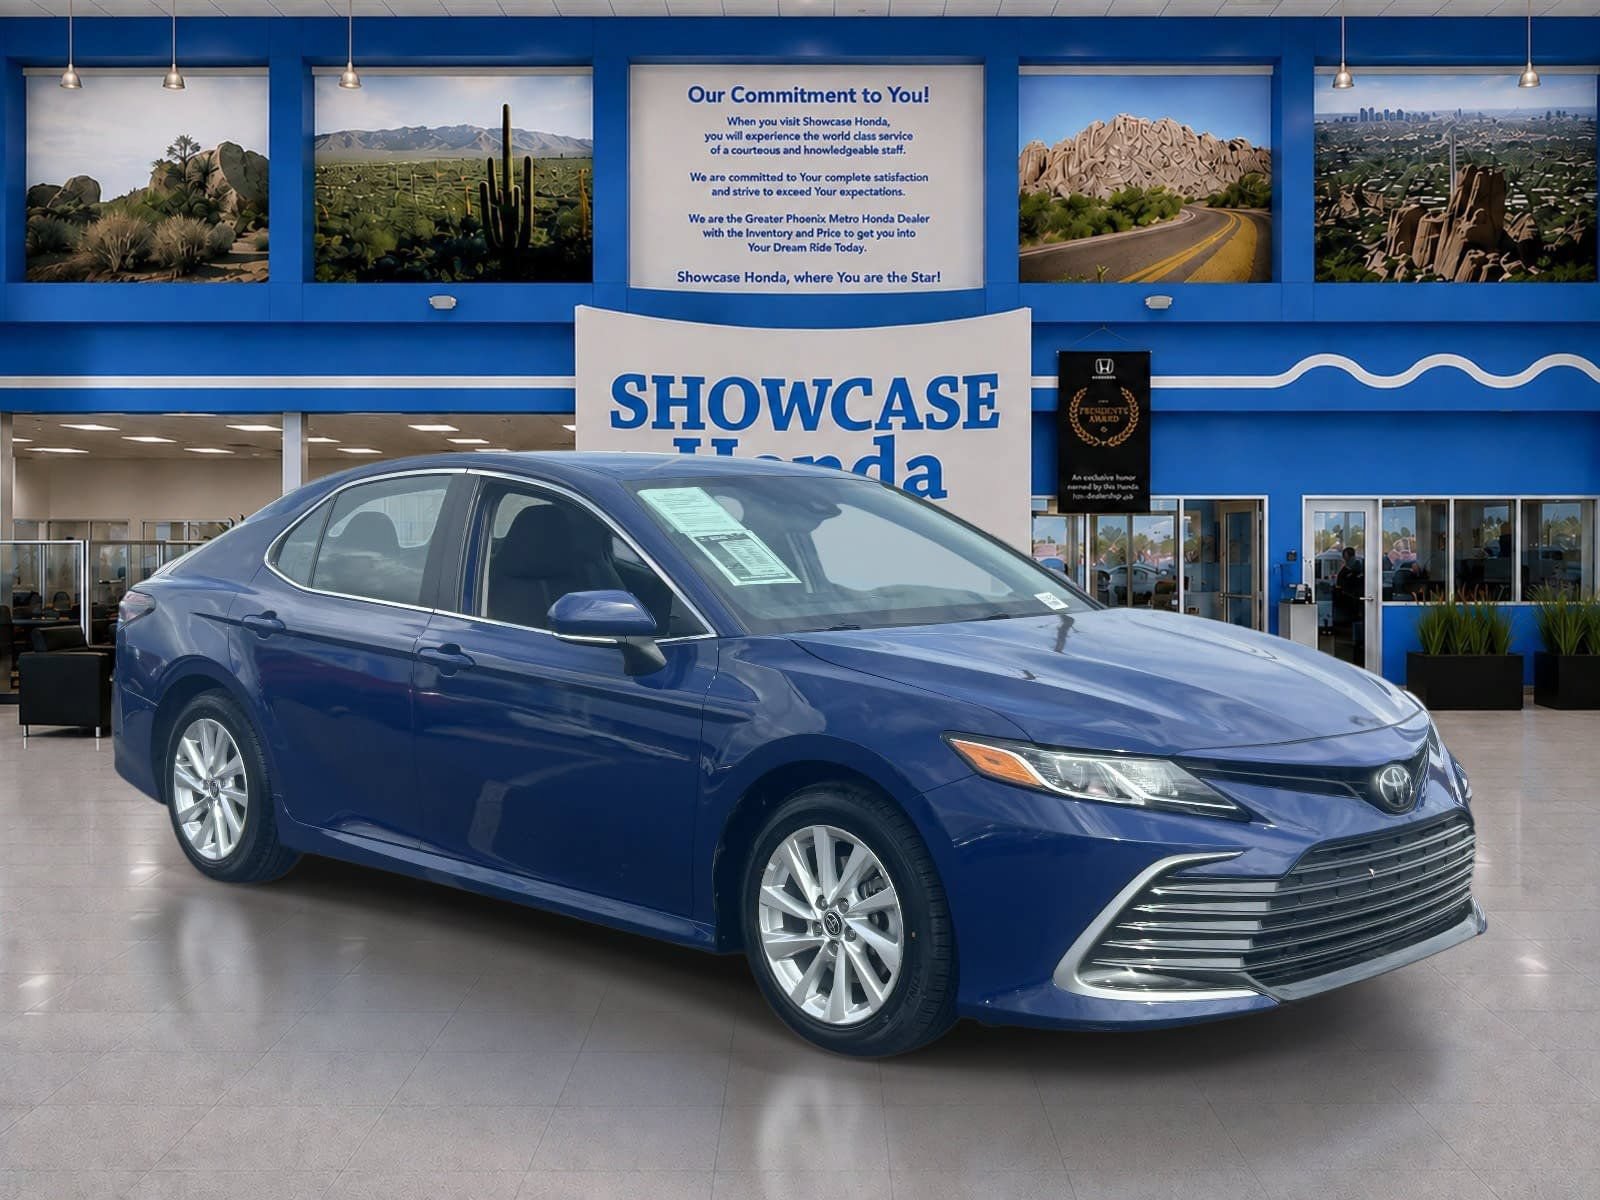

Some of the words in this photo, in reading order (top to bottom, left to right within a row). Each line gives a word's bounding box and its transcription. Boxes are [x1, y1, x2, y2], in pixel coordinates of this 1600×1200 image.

[687, 85, 727, 104] Our
[730, 85, 858, 104] Commitment
[860, 87, 883, 104] to
[886, 85, 930, 104] You!
[726, 116, 757, 127] When
[758, 118, 778, 129] you
[779, 116, 801, 127] visit
[802, 115, 853, 127] Showcase
[854, 116, 891, 129] Honda,
[704, 133, 724, 144] you
[724, 130, 744, 141] will
[744, 131, 801, 144] experience
[802, 130, 821, 141] the
[821, 130, 851, 142] world
[852, 130, 877, 142] class
[878, 131, 914, 142] service
[709, 144, 722, 155] of
[722, 147, 730, 155] a
[730, 146, 781, 156] courteous
[782, 144, 802, 155] and
[881, 143, 907, 155] staff.
[689, 171, 708, 183] We
[708, 174, 727, 182] are
[727, 171, 784, 183] committed
[785, 173, 798, 183] to
[799, 172, 823, 183] Your
[824, 171, 872, 186] complete
[873, 171, 929, 183] satisfaction
[711, 185, 731, 197] and
[731, 186, 761, 197] strive
[762, 187, 774, 197] to
[775, 186, 813, 197] exceed
[813, 186, 838, 197] Your
[838, 186, 906, 200] expectations.
[688, 213, 707, 224] We
[707, 215, 725, 224] are
[725, 213, 744, 224] the
[744, 213, 785, 224] Greater
[785, 213, 827, 224] Phoenix
[828, 213, 860, 224] Metro
[861, 213, 896, 224] Honda
[897, 213, 931, 224] Dealer
[702, 227, 725, 238] with
[726, 227, 744, 239] the
[745, 227, 794, 241] Inventory
[794, 227, 815, 239] and
[816, 227, 842, 239] Price
[843, 229, 856, 239] to
[856, 229, 875, 241] get
[875, 229, 895, 241] you
[896, 227, 917, 239] into
[747, 242, 772, 253] Your
[772, 242, 808, 253] Dream
[809, 242, 833, 253] Ride
[833, 242, 868, 255] Today.
[677, 270, 741, 284] Showcase
[744, 270, 790, 286] Honda,
[793, 270, 834, 284] where
[836, 271, 861, 284] You
[863, 273, 884, 284] are
[886, 270, 908, 284] the
[910, 270, 941, 284] Star!
[610, 373, 1000, 431] SHOWCASE
